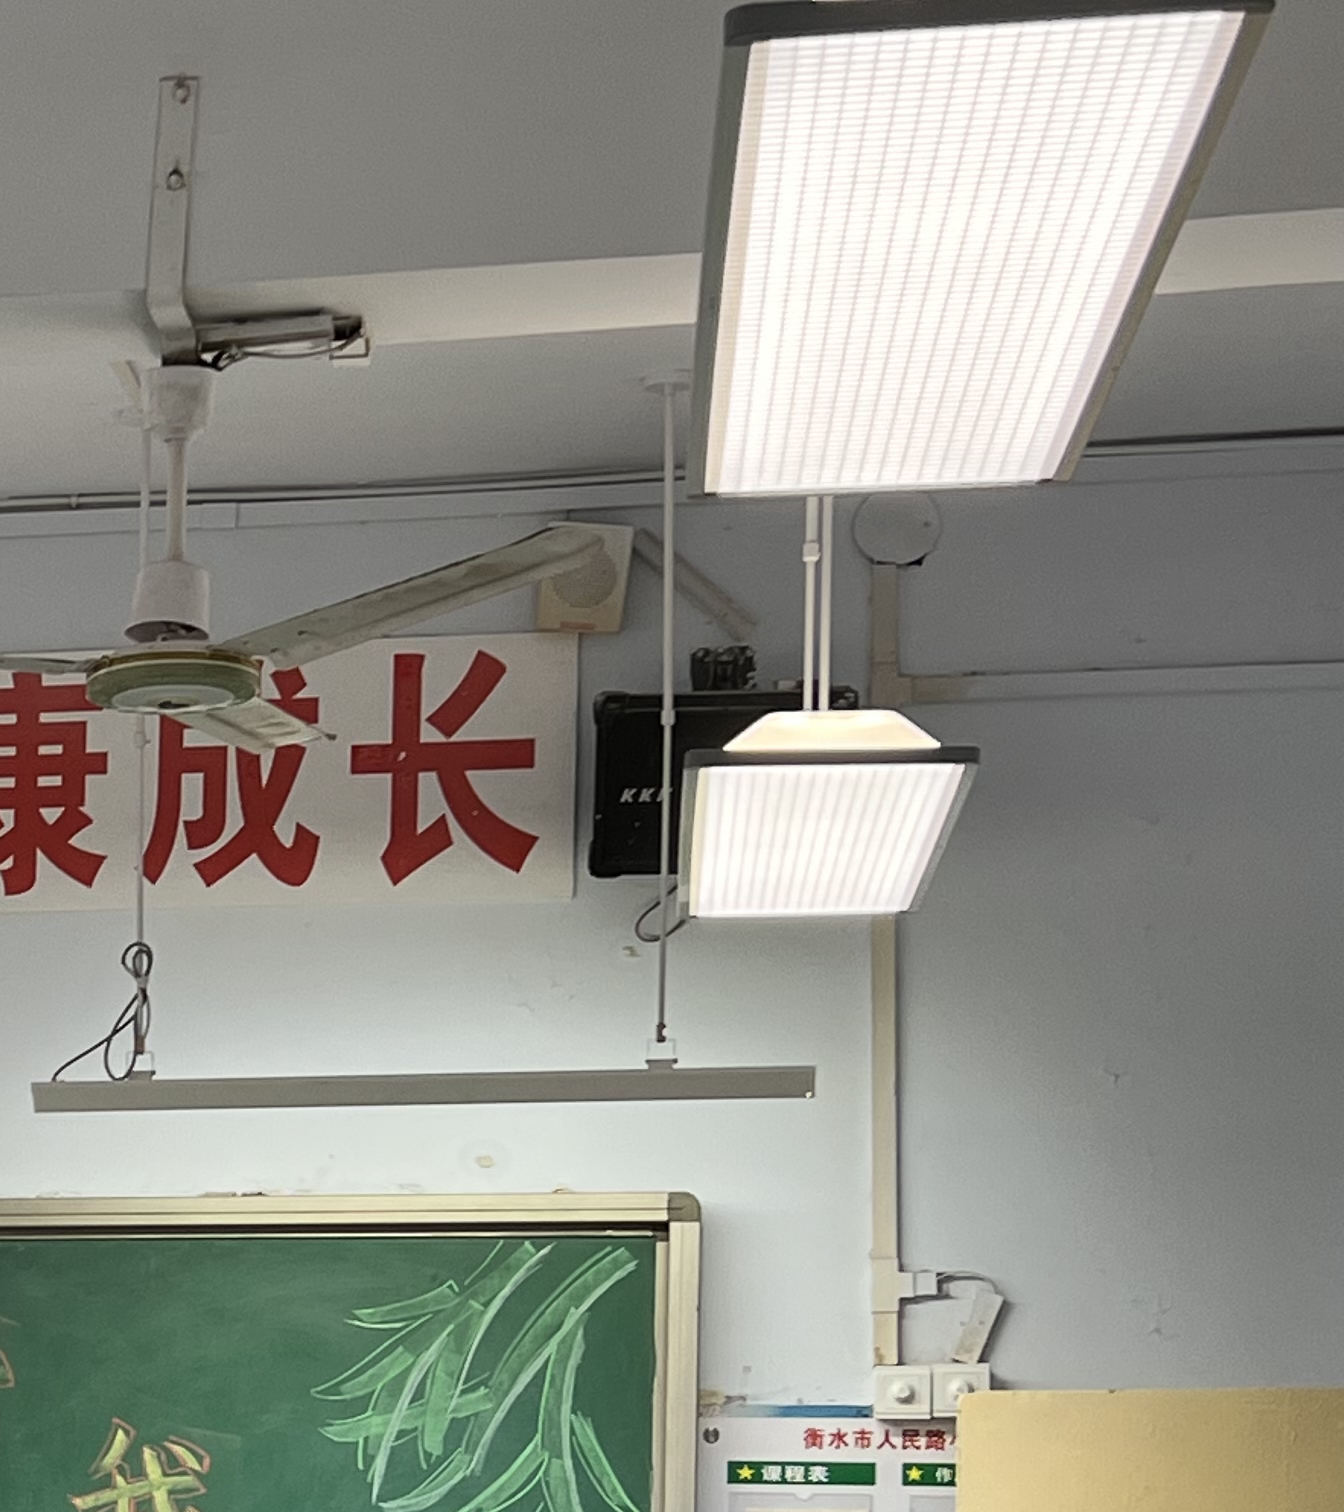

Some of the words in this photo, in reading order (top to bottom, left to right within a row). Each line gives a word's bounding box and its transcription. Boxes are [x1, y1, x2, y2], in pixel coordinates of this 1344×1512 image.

[803, 1427, 957, 1451] 衡水市人民路
[760, 1465, 830, 1483] 课程表
[935, 1466, 957, 1484] 作
